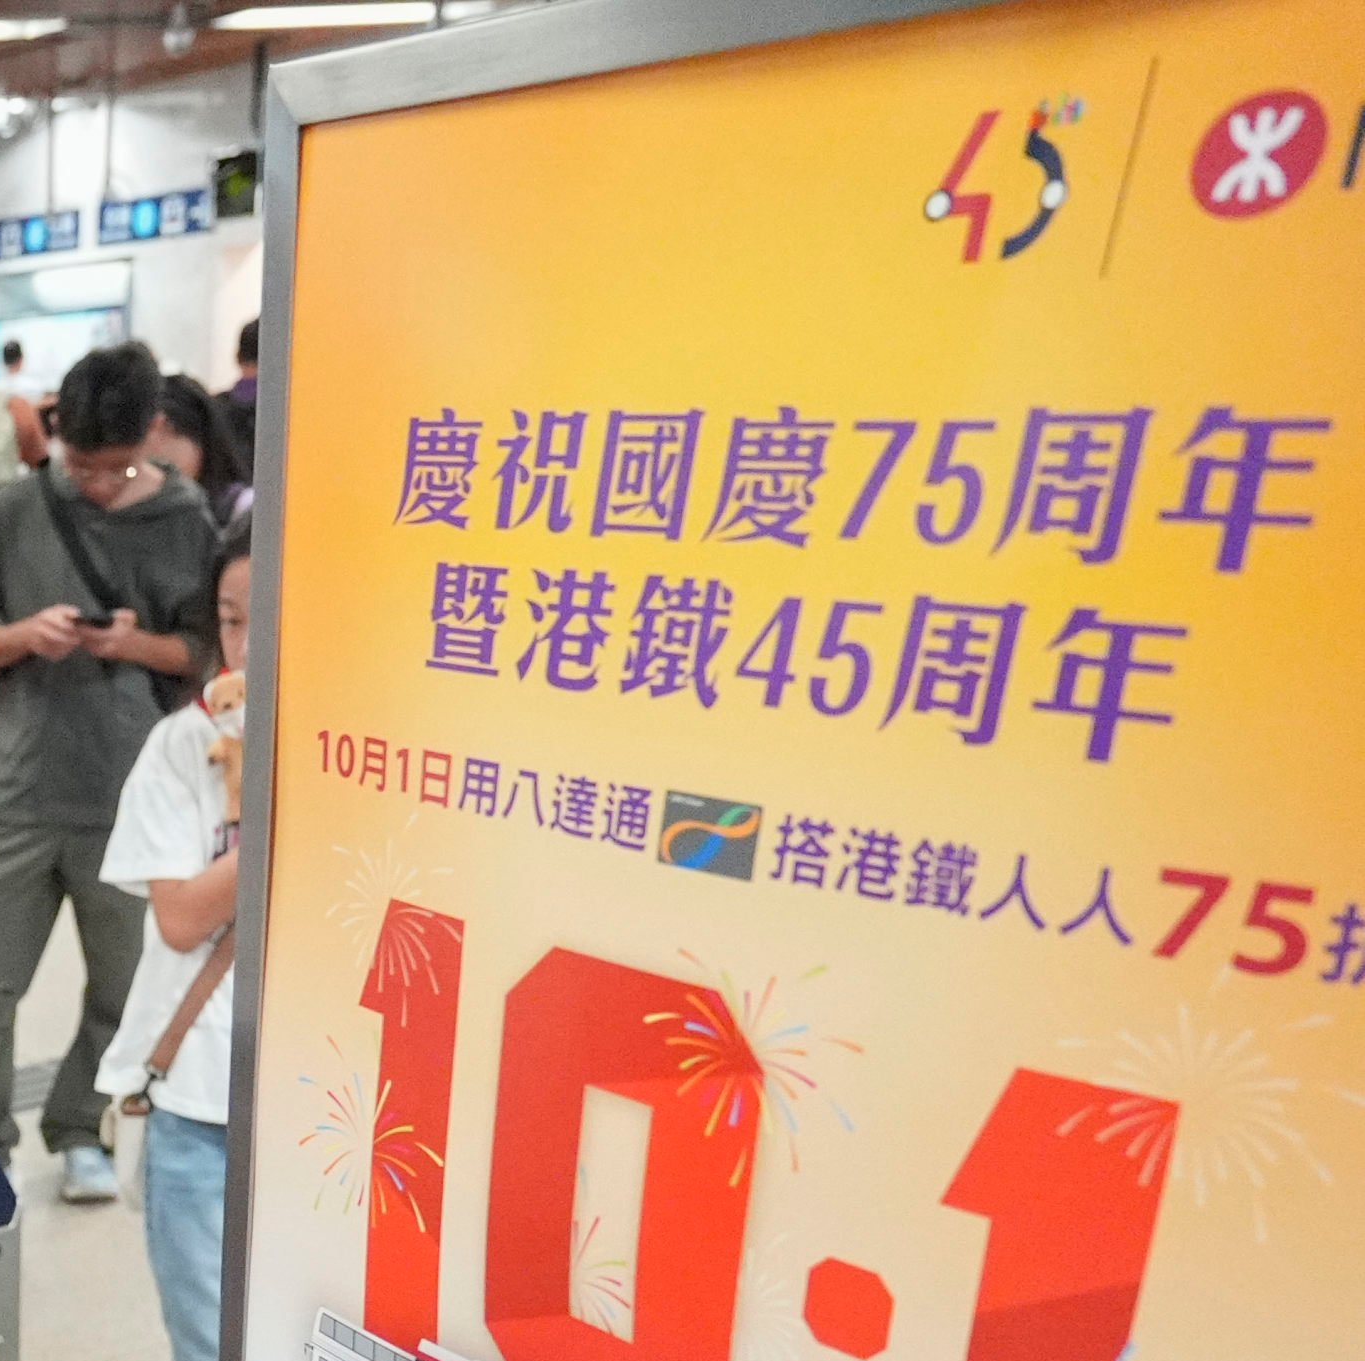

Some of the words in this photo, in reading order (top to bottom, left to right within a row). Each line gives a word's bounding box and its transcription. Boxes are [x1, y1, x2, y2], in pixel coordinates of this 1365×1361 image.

[392, 405, 1333, 574] 慶祝國慶75周年
[424, 562, 1192, 764] 暨港鐵45周年
[315, 729, 653, 852] 10月1日用八達通
